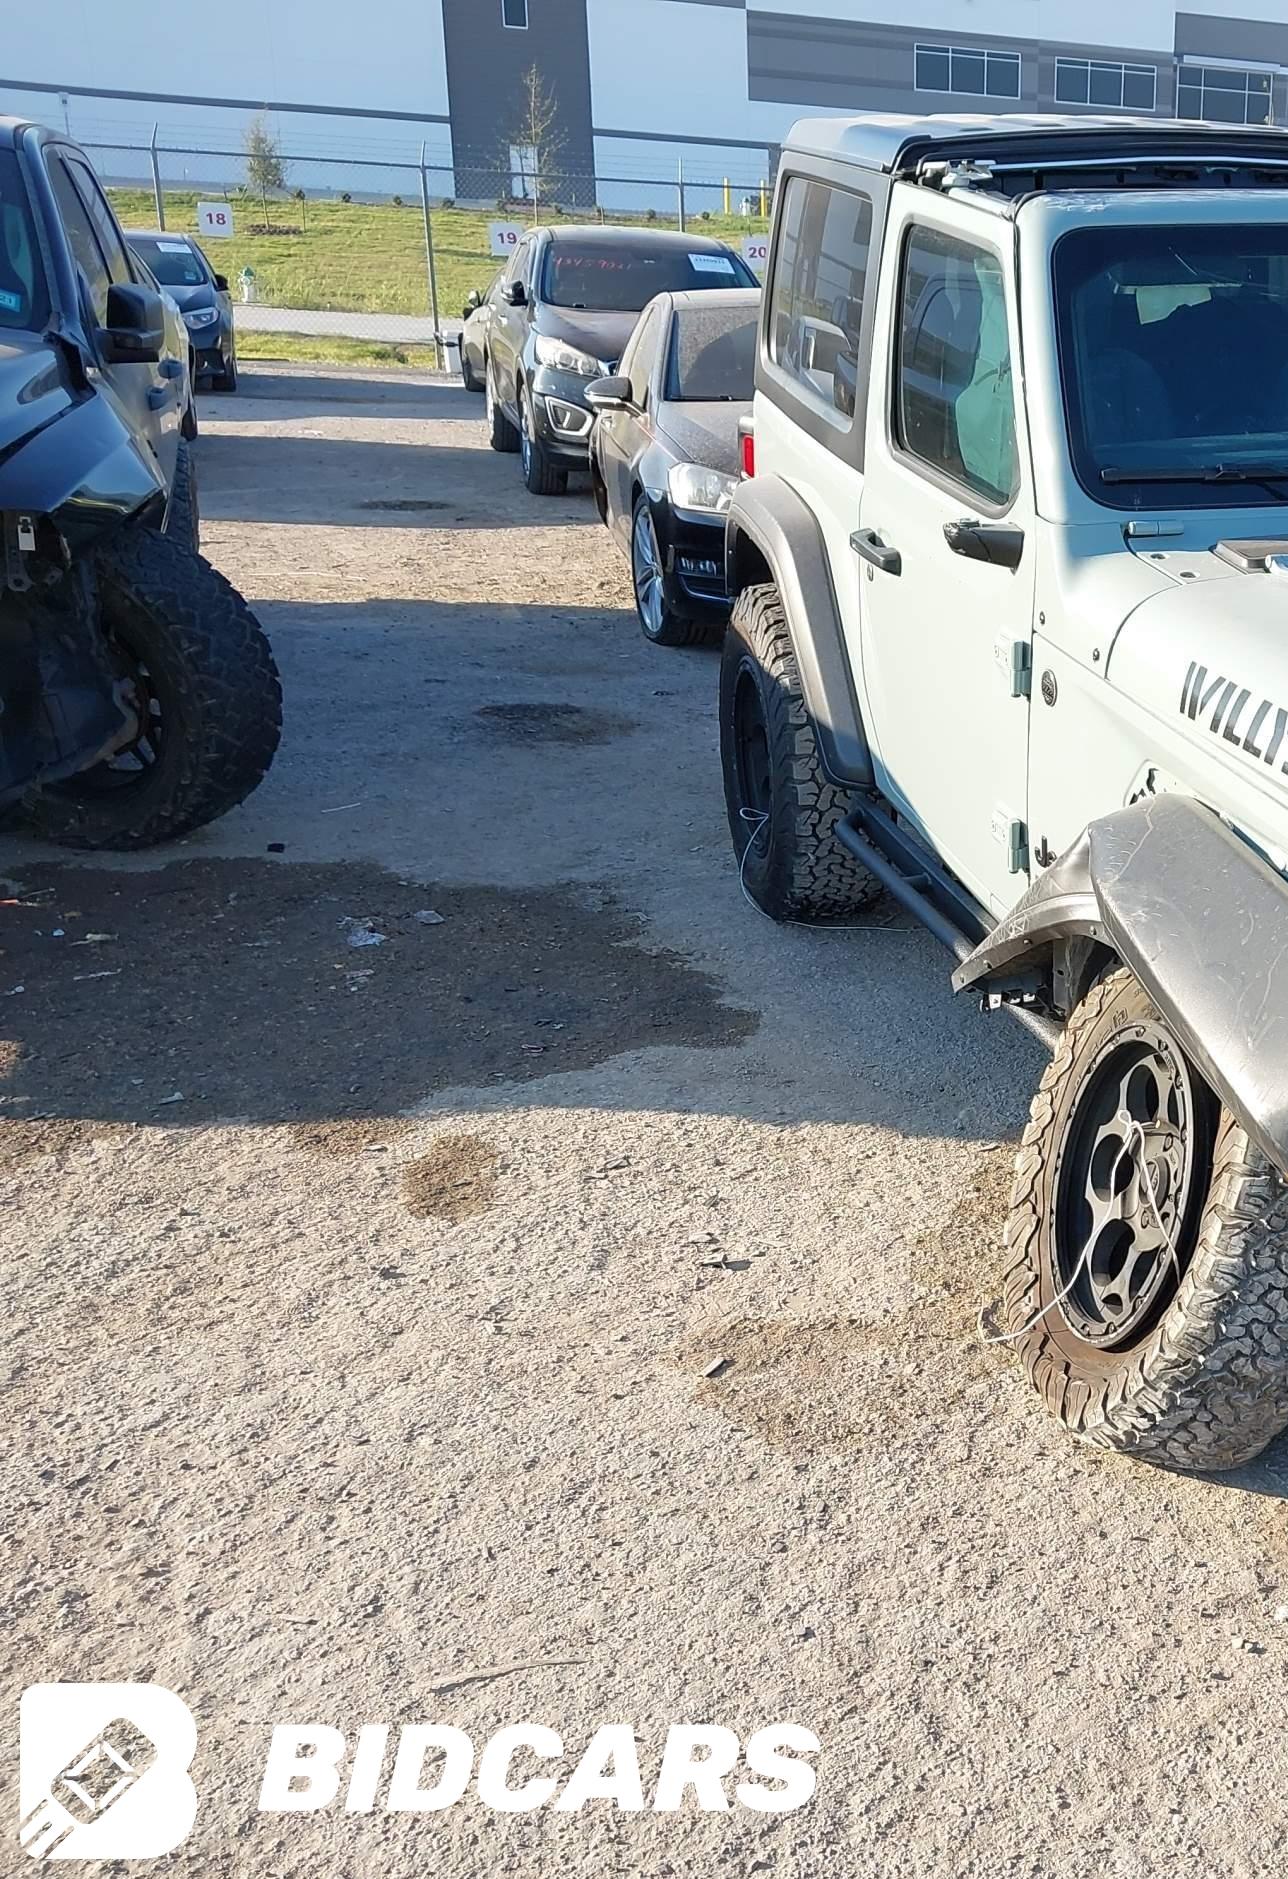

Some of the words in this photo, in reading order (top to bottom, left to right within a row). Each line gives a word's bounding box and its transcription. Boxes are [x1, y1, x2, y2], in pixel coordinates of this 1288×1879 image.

[206, 212, 226, 225] 18
[497, 232, 517, 244] 19
[748, 246, 767, 259] 20
